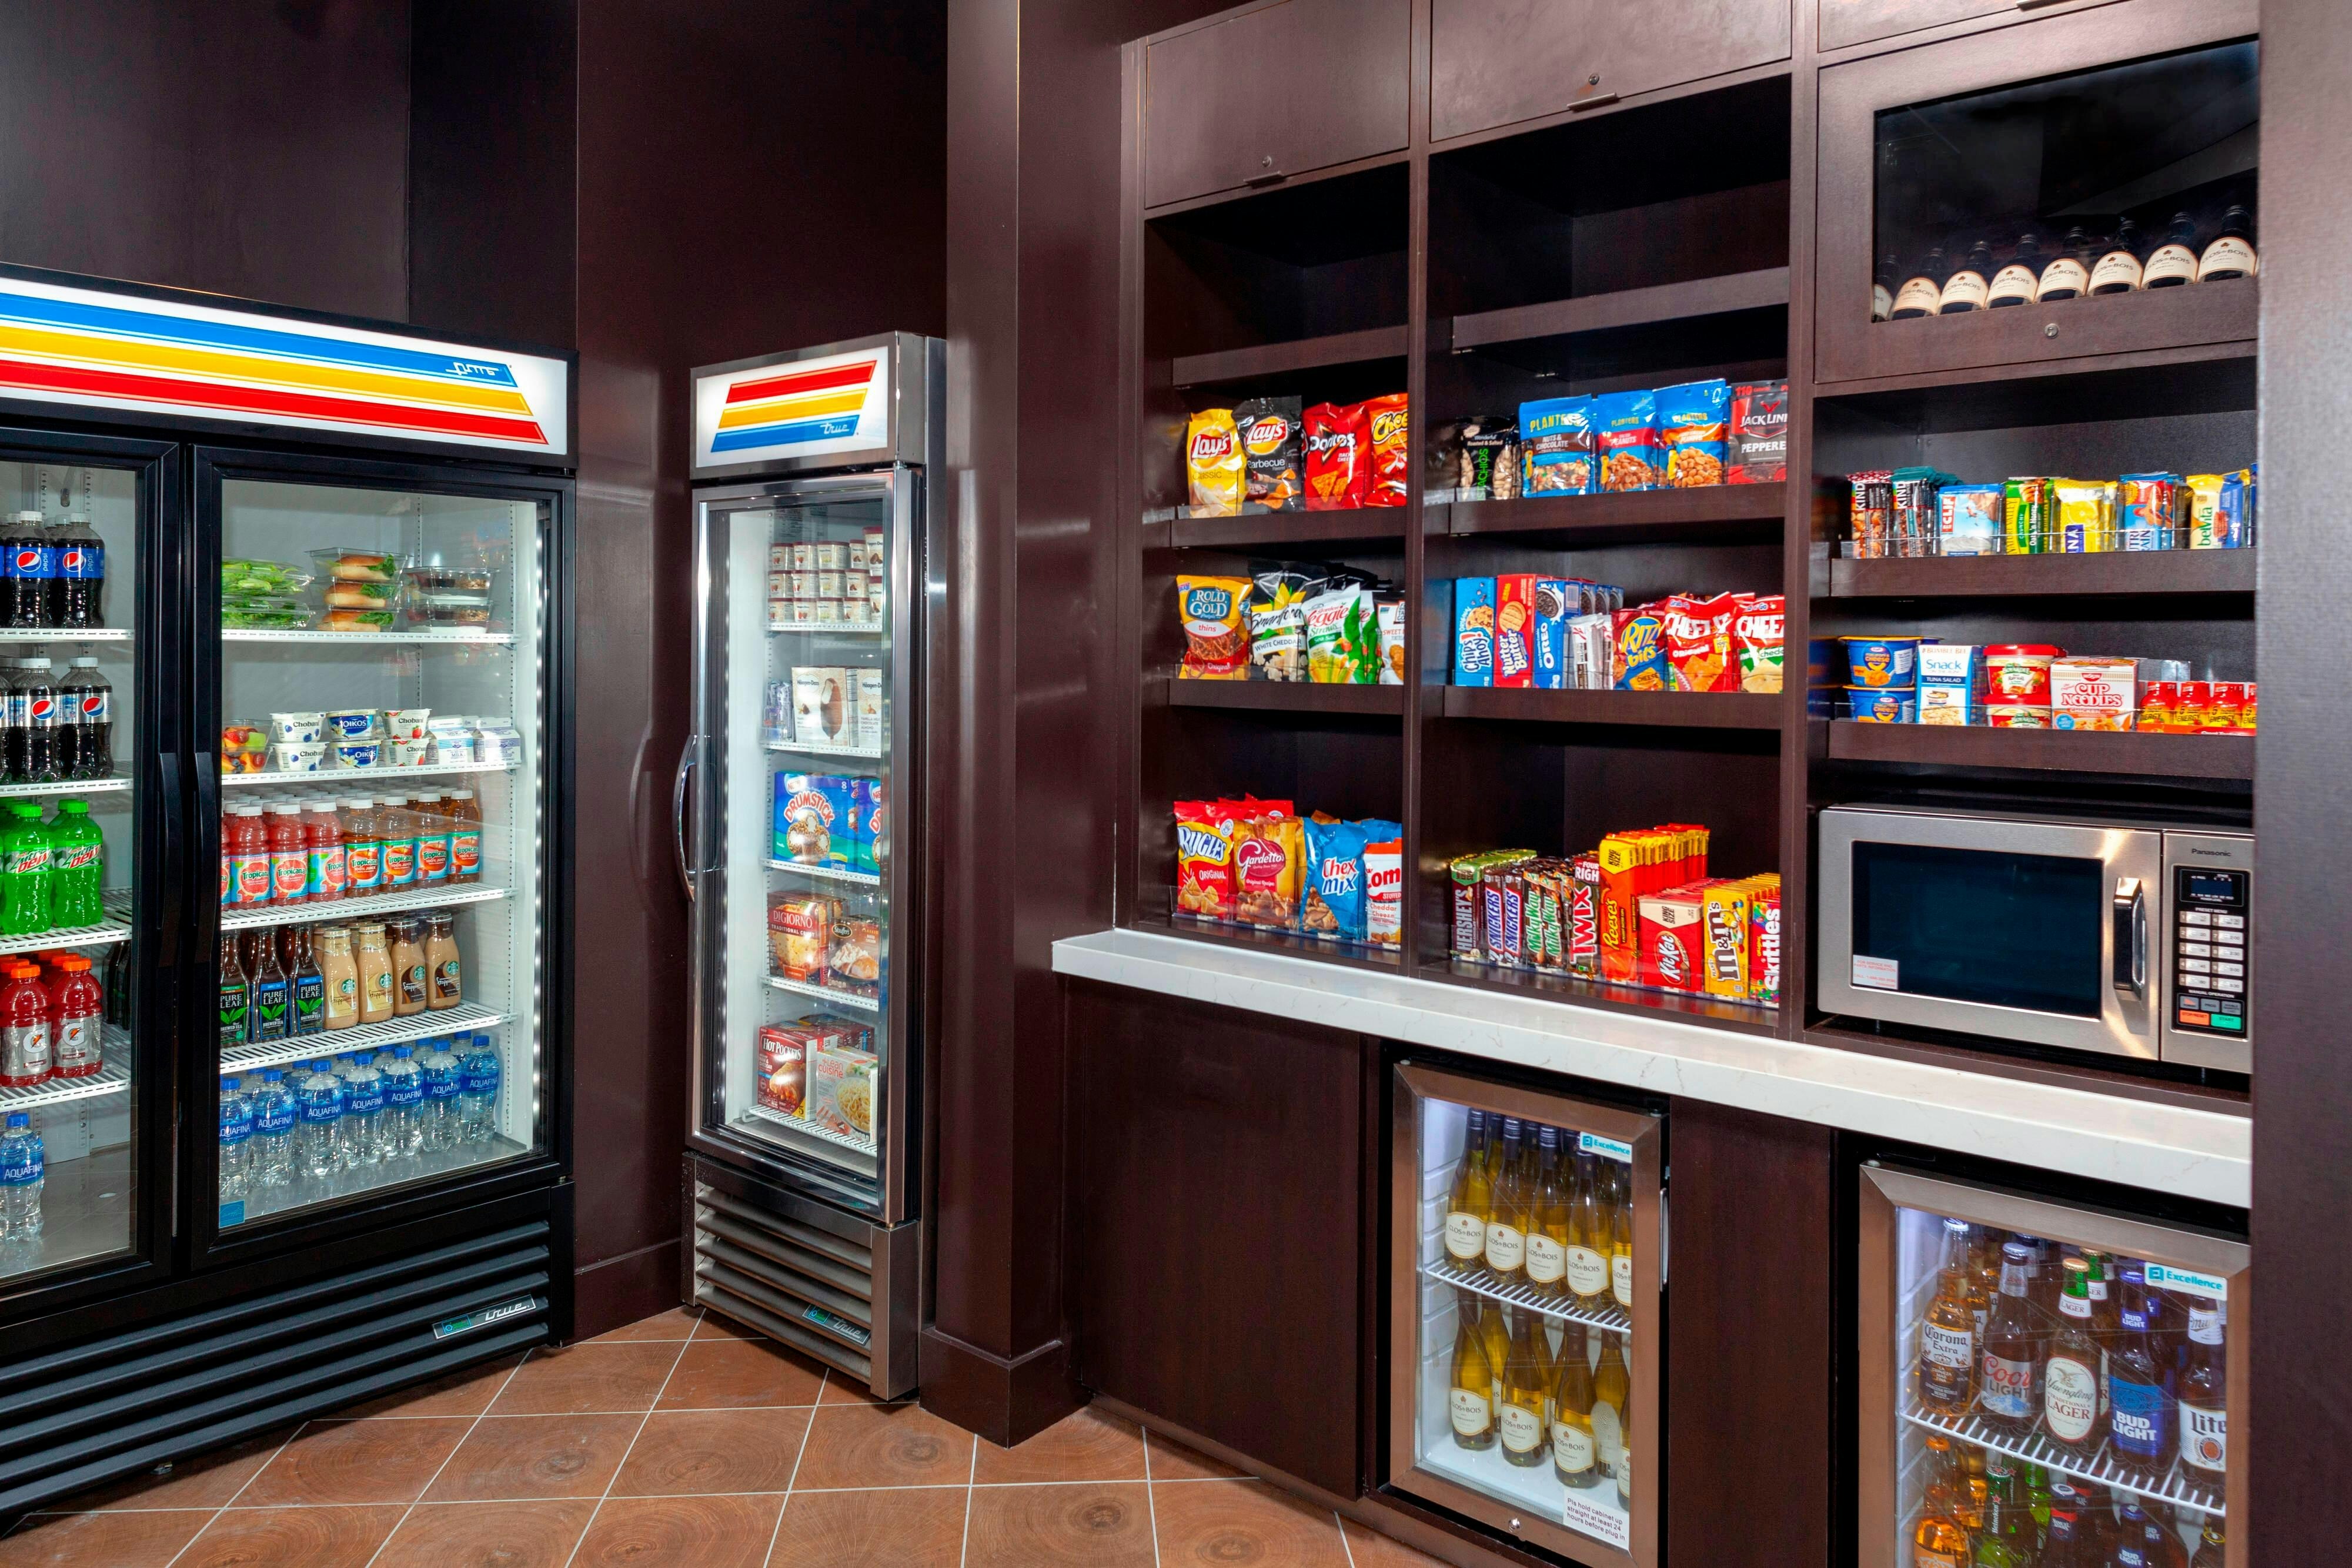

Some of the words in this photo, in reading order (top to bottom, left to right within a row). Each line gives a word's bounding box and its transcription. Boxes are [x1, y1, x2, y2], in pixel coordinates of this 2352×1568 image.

[820, 423, 850, 434] true
[1740, 415, 1766, 427] JACK
[1248, 422, 1288, 444] Lay's
[1192, 434, 1231, 457] Lay's
[1309, 433, 1355, 450] Doritos
[1536, 440, 1569, 450] CHOCOLATE
[1247, 459, 1285, 469] Barbecue
[1856, 483, 1866, 510] KIND
[1897, 482, 1906, 509] KIND
[1197, 590, 1225, 602] ROLD
[1190, 600, 1228, 617] GOLD
[1251, 607, 1302, 629] Smartfood
[1305, 607, 1349, 627] Veggie
[1198, 624, 1217, 633] thins
[1255, 640, 1272, 652] WHITE
[1273, 638, 1302, 647] CHEDDAR
[1541, 623, 1554, 668] OREO
[1621, 623, 1661, 653] RITZ
[1463, 640, 1479, 671] Chips
[1499, 634, 1516, 676] Nutter
[1508, 629, 1527, 670] Butter
[1628, 646, 1656, 667] bits
[1207, 662, 1231, 671] Original
[1926, 659, 1962, 670] Snack
[1637, 673, 1658, 682] CHEESE
[2075, 683, 2110, 695] CUP
[2062, 693, 2122, 707] NOODLES
[784, 791, 835, 828] DRUMSTICK
[1178, 825, 1226, 862] BUGLES
[1237, 840, 1285, 880] Gardetto's
[2191, 848, 2231, 857] Panasonic
[352, 858, 377, 867] Tropicana
[1322, 856, 1357, 877] Chex
[1582, 861, 1599, 870] FOUR
[278, 868, 306, 877] Tropicana
[1199, 870, 1226, 880] ORIGINAL
[1575, 867, 1599, 882] RIGH
[1322, 874, 1357, 895] mix
[1370, 903, 1397, 911] Cheddar
[773, 911, 813, 928] DIGIORNO
[1455, 888, 1472, 951] HERSHEY'S
[1486, 891, 1502, 950] SNICKERS
[1505, 892, 1519, 952] SNICKERS
[1570, 885, 1597, 964] TWIX
[1603, 898, 1619, 950] Reese's
[771, 924, 799, 934] TRADITIONAL
[1708, 959, 1716, 977] PEANUT
[220, 994, 242, 1002] PURE
[263, 990, 283, 998] PURE
[62, 1023, 85, 1046] G
[763, 1038, 775, 1052] HOT
[776, 1043, 801, 1060] POCKETS
[432, 1082, 460, 1095] AQUAFINA
[470, 1076, 498, 1088] AQUAFINA
[352, 1096, 383, 1109] AQUAFINA
[392, 1089, 422, 1102] AQUAFINA
[308, 1104, 341, 1117] AQUAFINA
[799, 1106, 804, 1115] 5
[258, 1115, 292, 1128] AQUAFINA
[1593, 1138, 1631, 1156] Excellence
[5, 1165, 43, 1179] AQUAFINA
[1449, 1225, 1462, 1235] CLOS
[1542, 1252, 1558, 1261] BOIS
[2166, 1272, 2223, 1290] Excellence
[2061, 1302, 2084, 1313] LAGER
[2123, 1319, 2145, 1328] LIGHT
[1924, 1325, 1968, 1346] Corona
[1933, 1342, 1957, 1355] Extra
[2047, 1373, 2094, 1401] Yuengling
[2047, 1396, 2090, 1419] LAGER
[2050, 1394, 2087, 1407] TRADITIONAL
[2116, 1410, 2150, 1429] BUD
[2112, 1419, 2157, 1440] LIGHT
[1569, 1443, 1585, 1452] BOIS
[1567, 1506, 1590, 1519] straight
[1598, 1518, 1613, 1528] least
[1578, 1502, 1591, 1512] hold
[1592, 1508, 1614, 1521] cabinet
[1567, 1513, 1584, 1523] hours
[1585, 1520, 1605, 1532] before
[1605, 1529, 1618, 1539] plug
[2119, 1553, 2143, 1566] LIGHT
[2122, 1549, 2139, 1560] BUD
